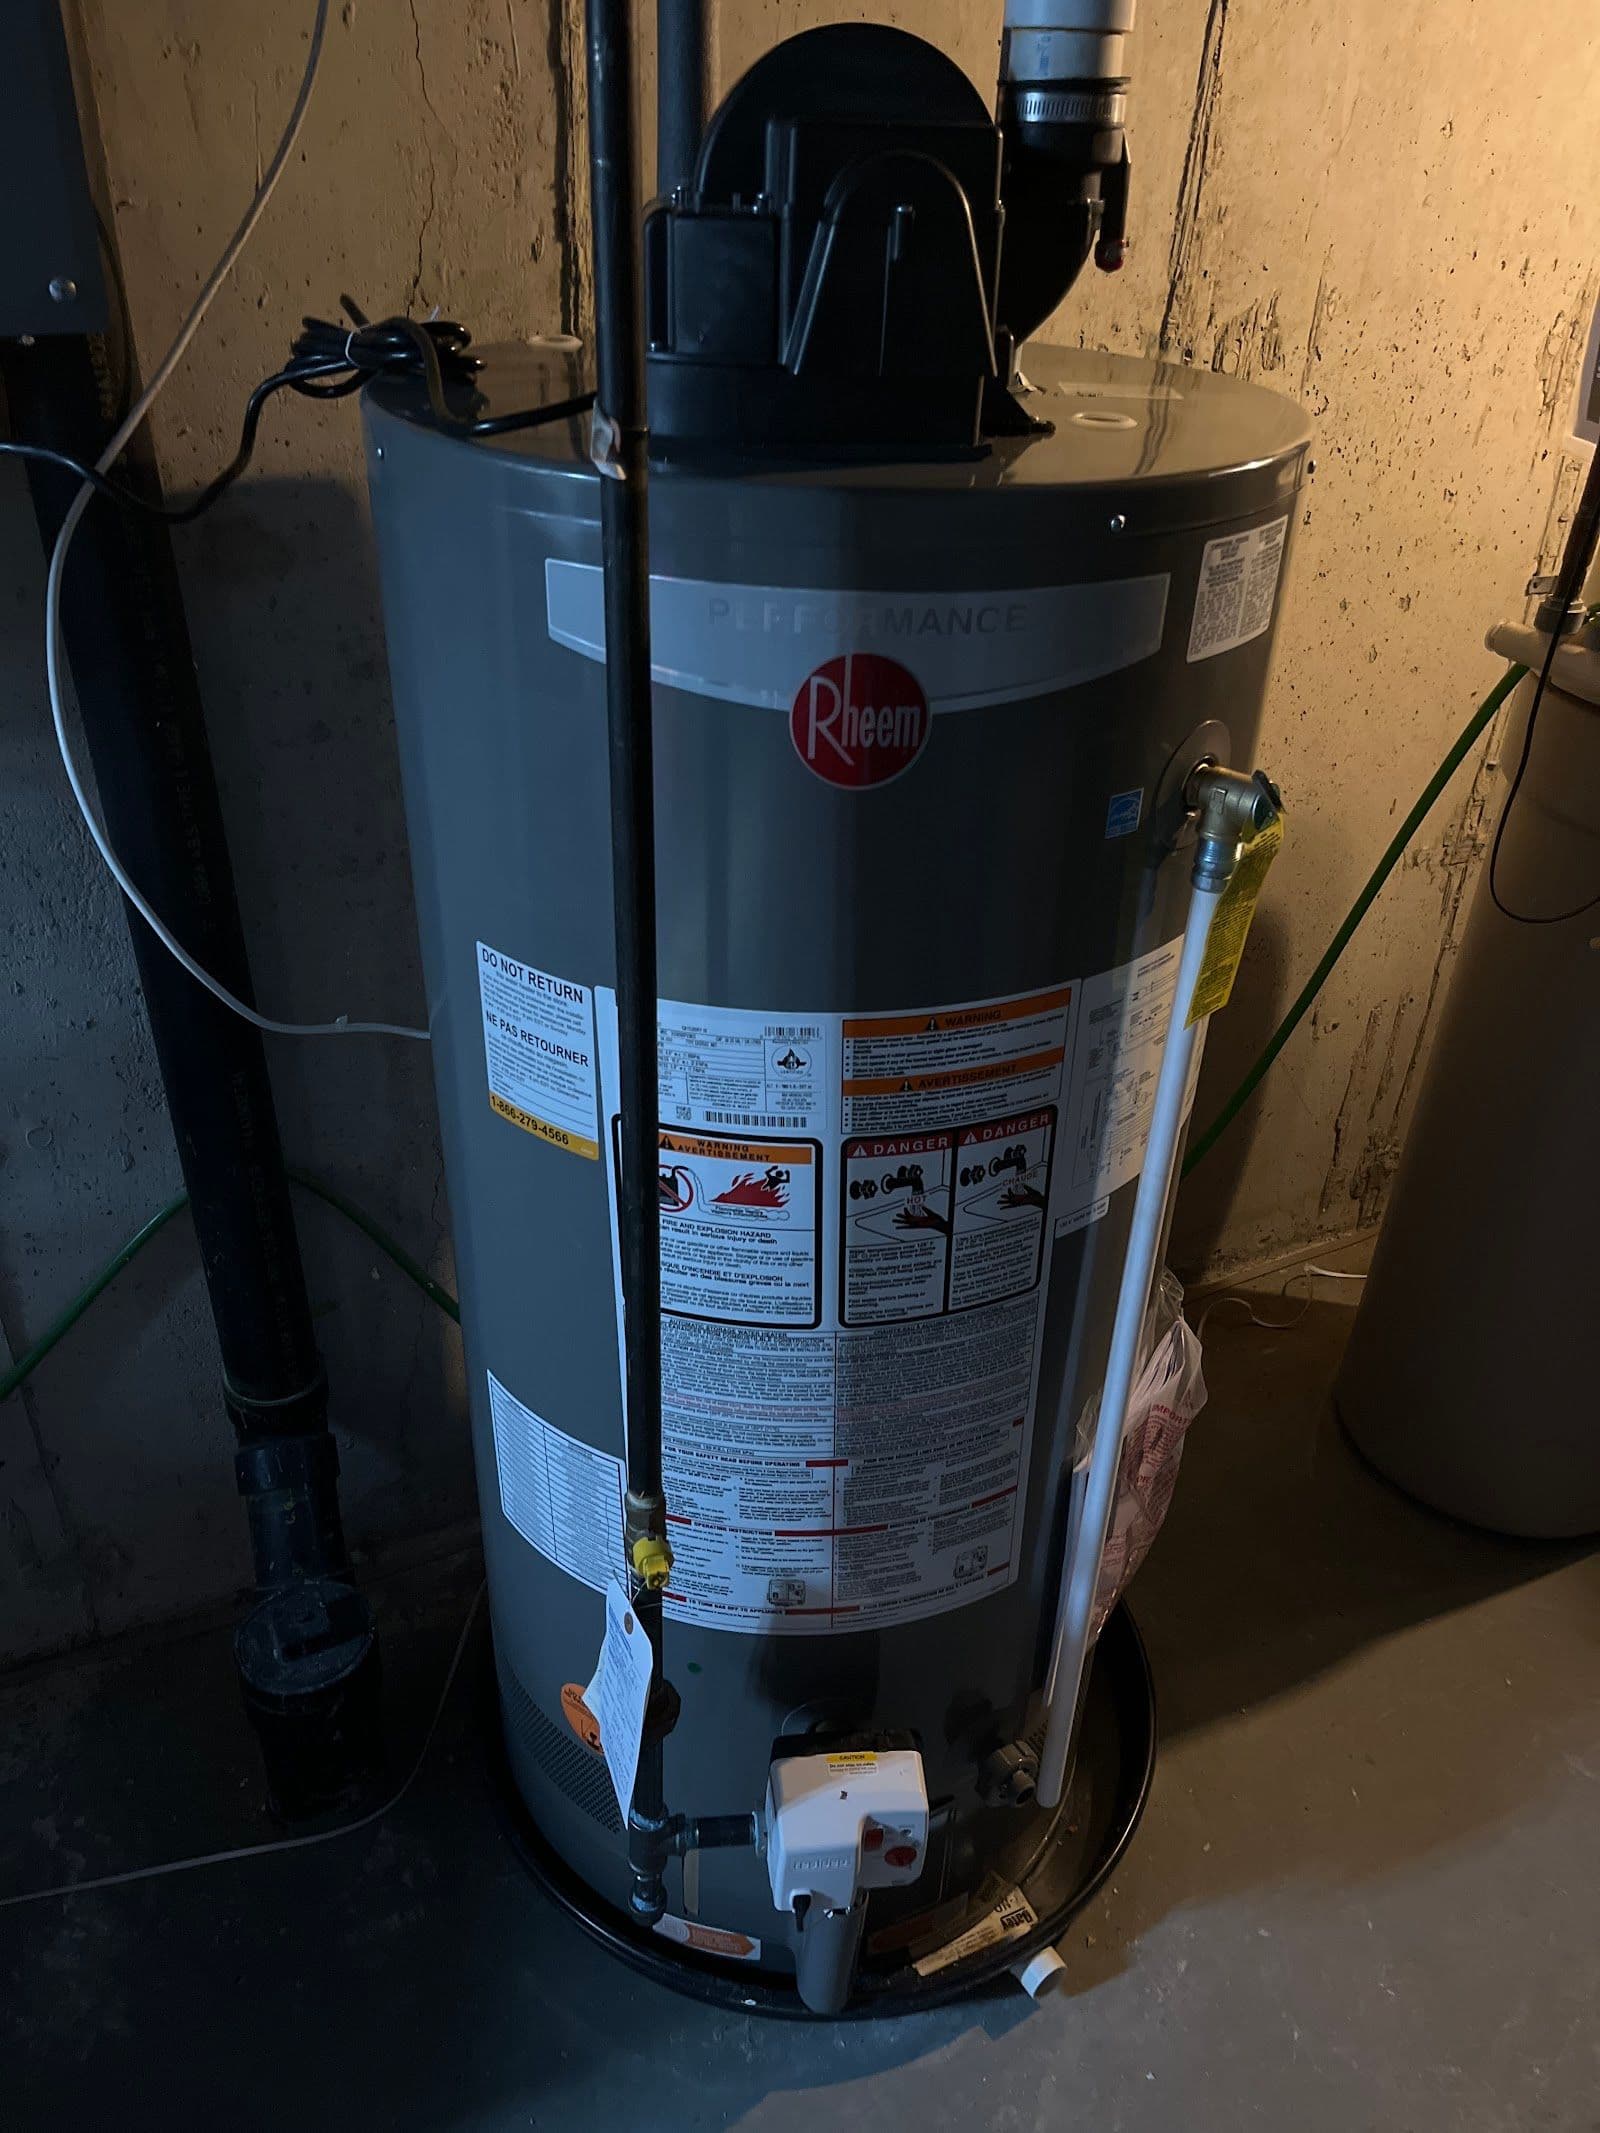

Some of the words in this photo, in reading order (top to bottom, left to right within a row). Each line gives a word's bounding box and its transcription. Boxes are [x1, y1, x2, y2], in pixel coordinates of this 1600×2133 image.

[807, 654, 920, 767] Rheem
[482, 948, 498, 968] DO
[501, 958, 525, 981] NOT
[528, 970, 583, 1004] RETURN
[945, 1010, 1001, 1027] WARNING
[486, 1010, 497, 1027] NE
[500, 1018, 518, 1038] PAS
[520, 1030, 589, 1068] RETOURNER
[919, 1064, 1017, 1089] AVERTISSEMENT
[491, 1095, 569, 1145] 1-866-279-4566
[983, 1113, 1050, 1139] DANGER
[677, 1145, 770, 1161] AVERTISSEMENT
[697, 1139, 749, 1152] WARNING
[873, 1136, 949, 1156] DANGER
[906, 1195, 926, 1204] HOT
